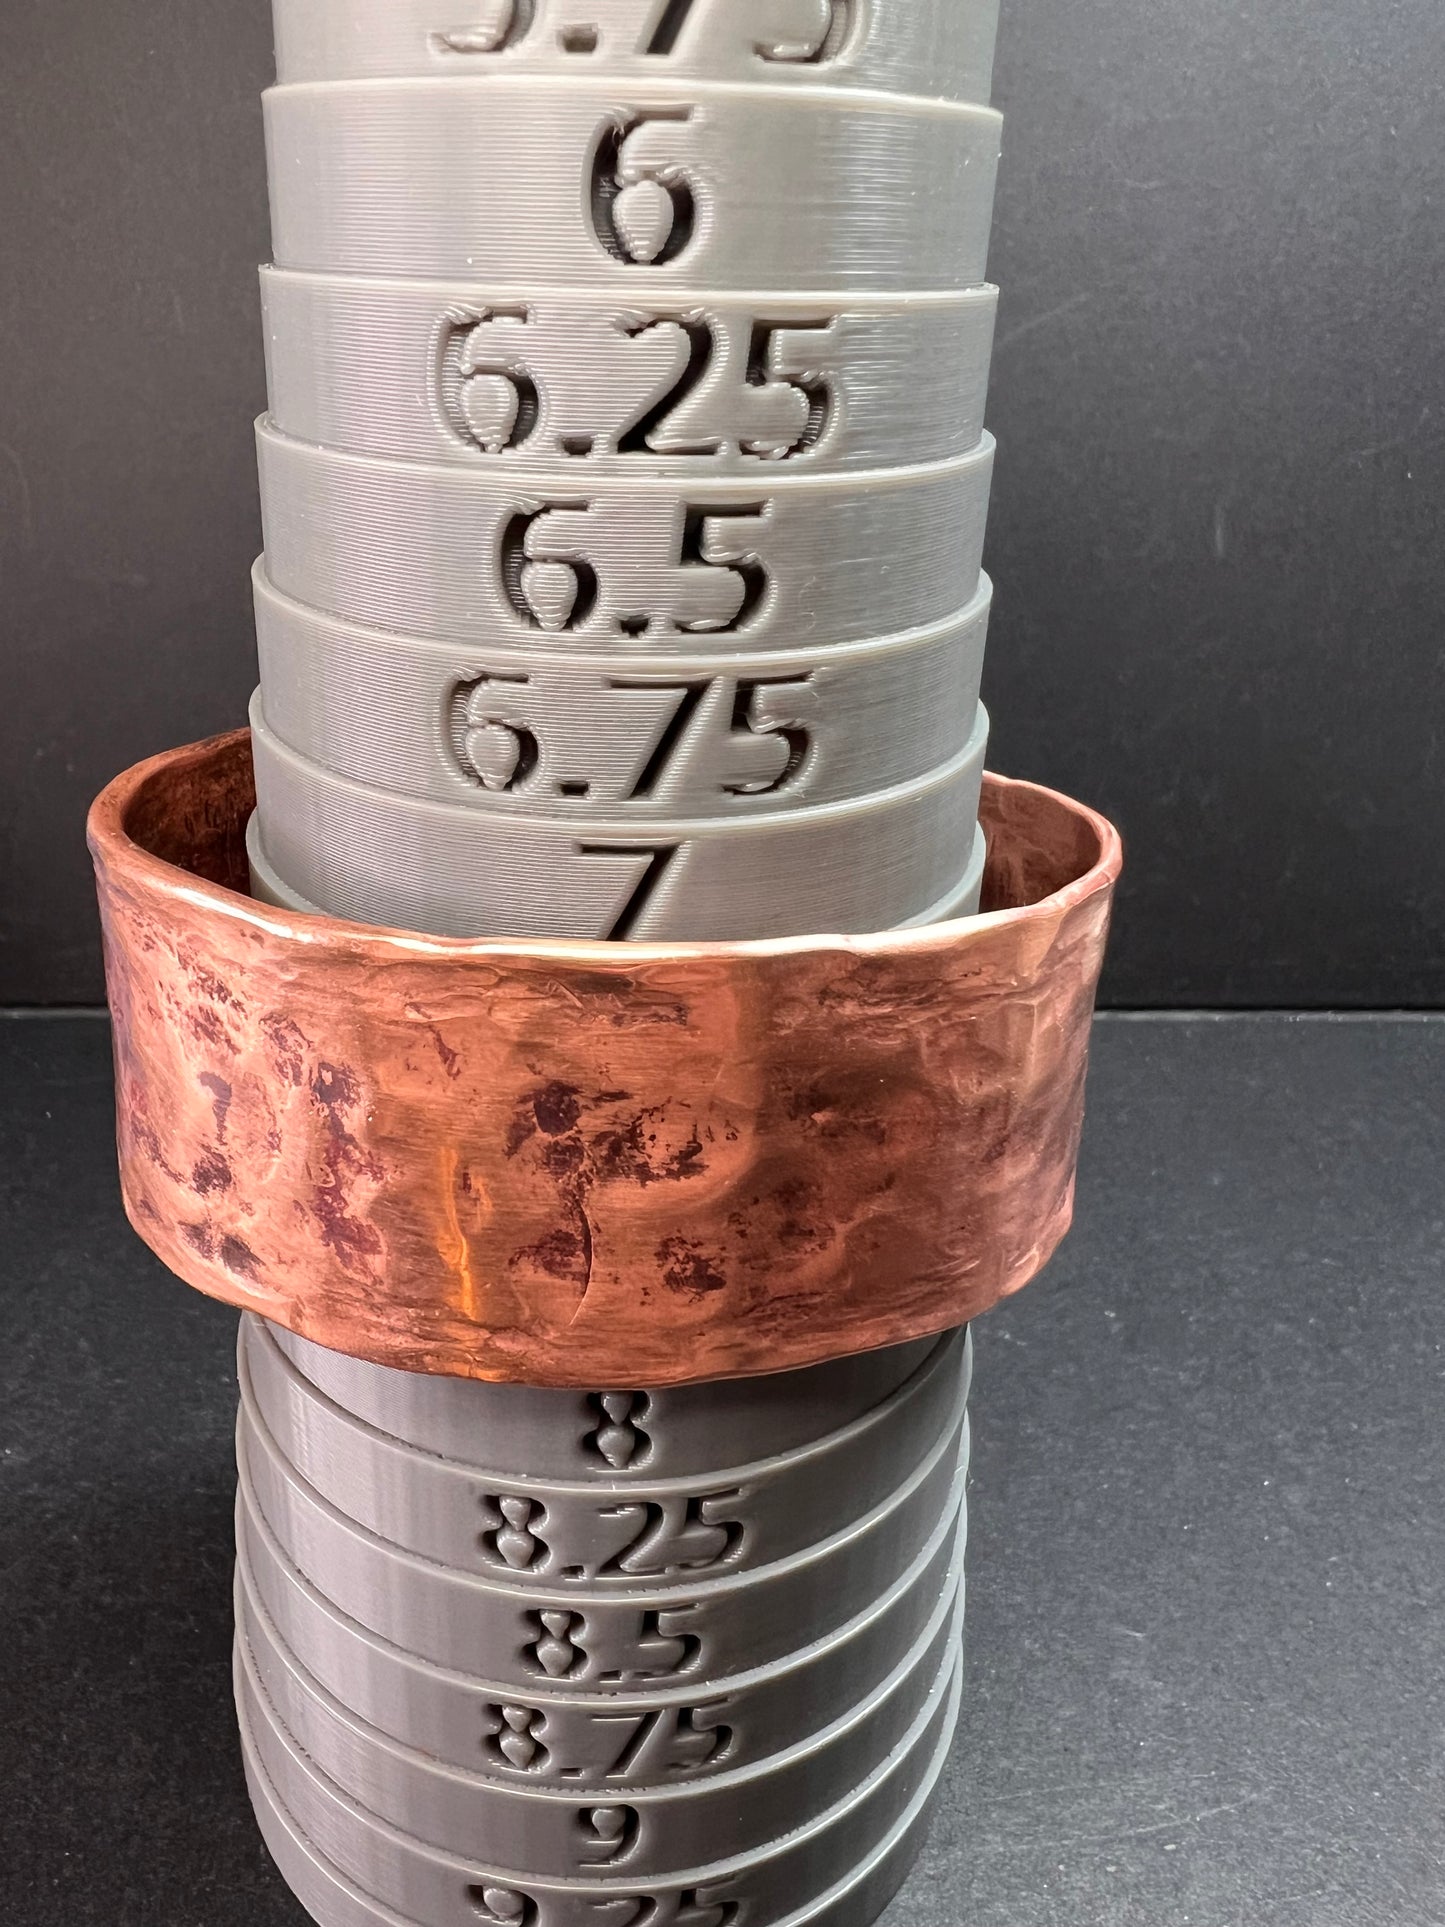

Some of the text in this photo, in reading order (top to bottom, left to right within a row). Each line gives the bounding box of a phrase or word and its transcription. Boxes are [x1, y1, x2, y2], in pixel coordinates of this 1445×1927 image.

[582, 103, 712, 266] 6
[428, 303, 842, 460] 6.25
[493, 498, 776, 638] 6.5
[438, 666, 826, 798] 6.75
[572, 838, 692, 941] 7
[582, 1390, 655, 1472] 8
[478, 1486, 748, 1581] 8.25
[518, 1601, 704, 1682] 8.5
[482, 1696, 734, 1779] 8.75
[573, 1803, 642, 1868] 9
